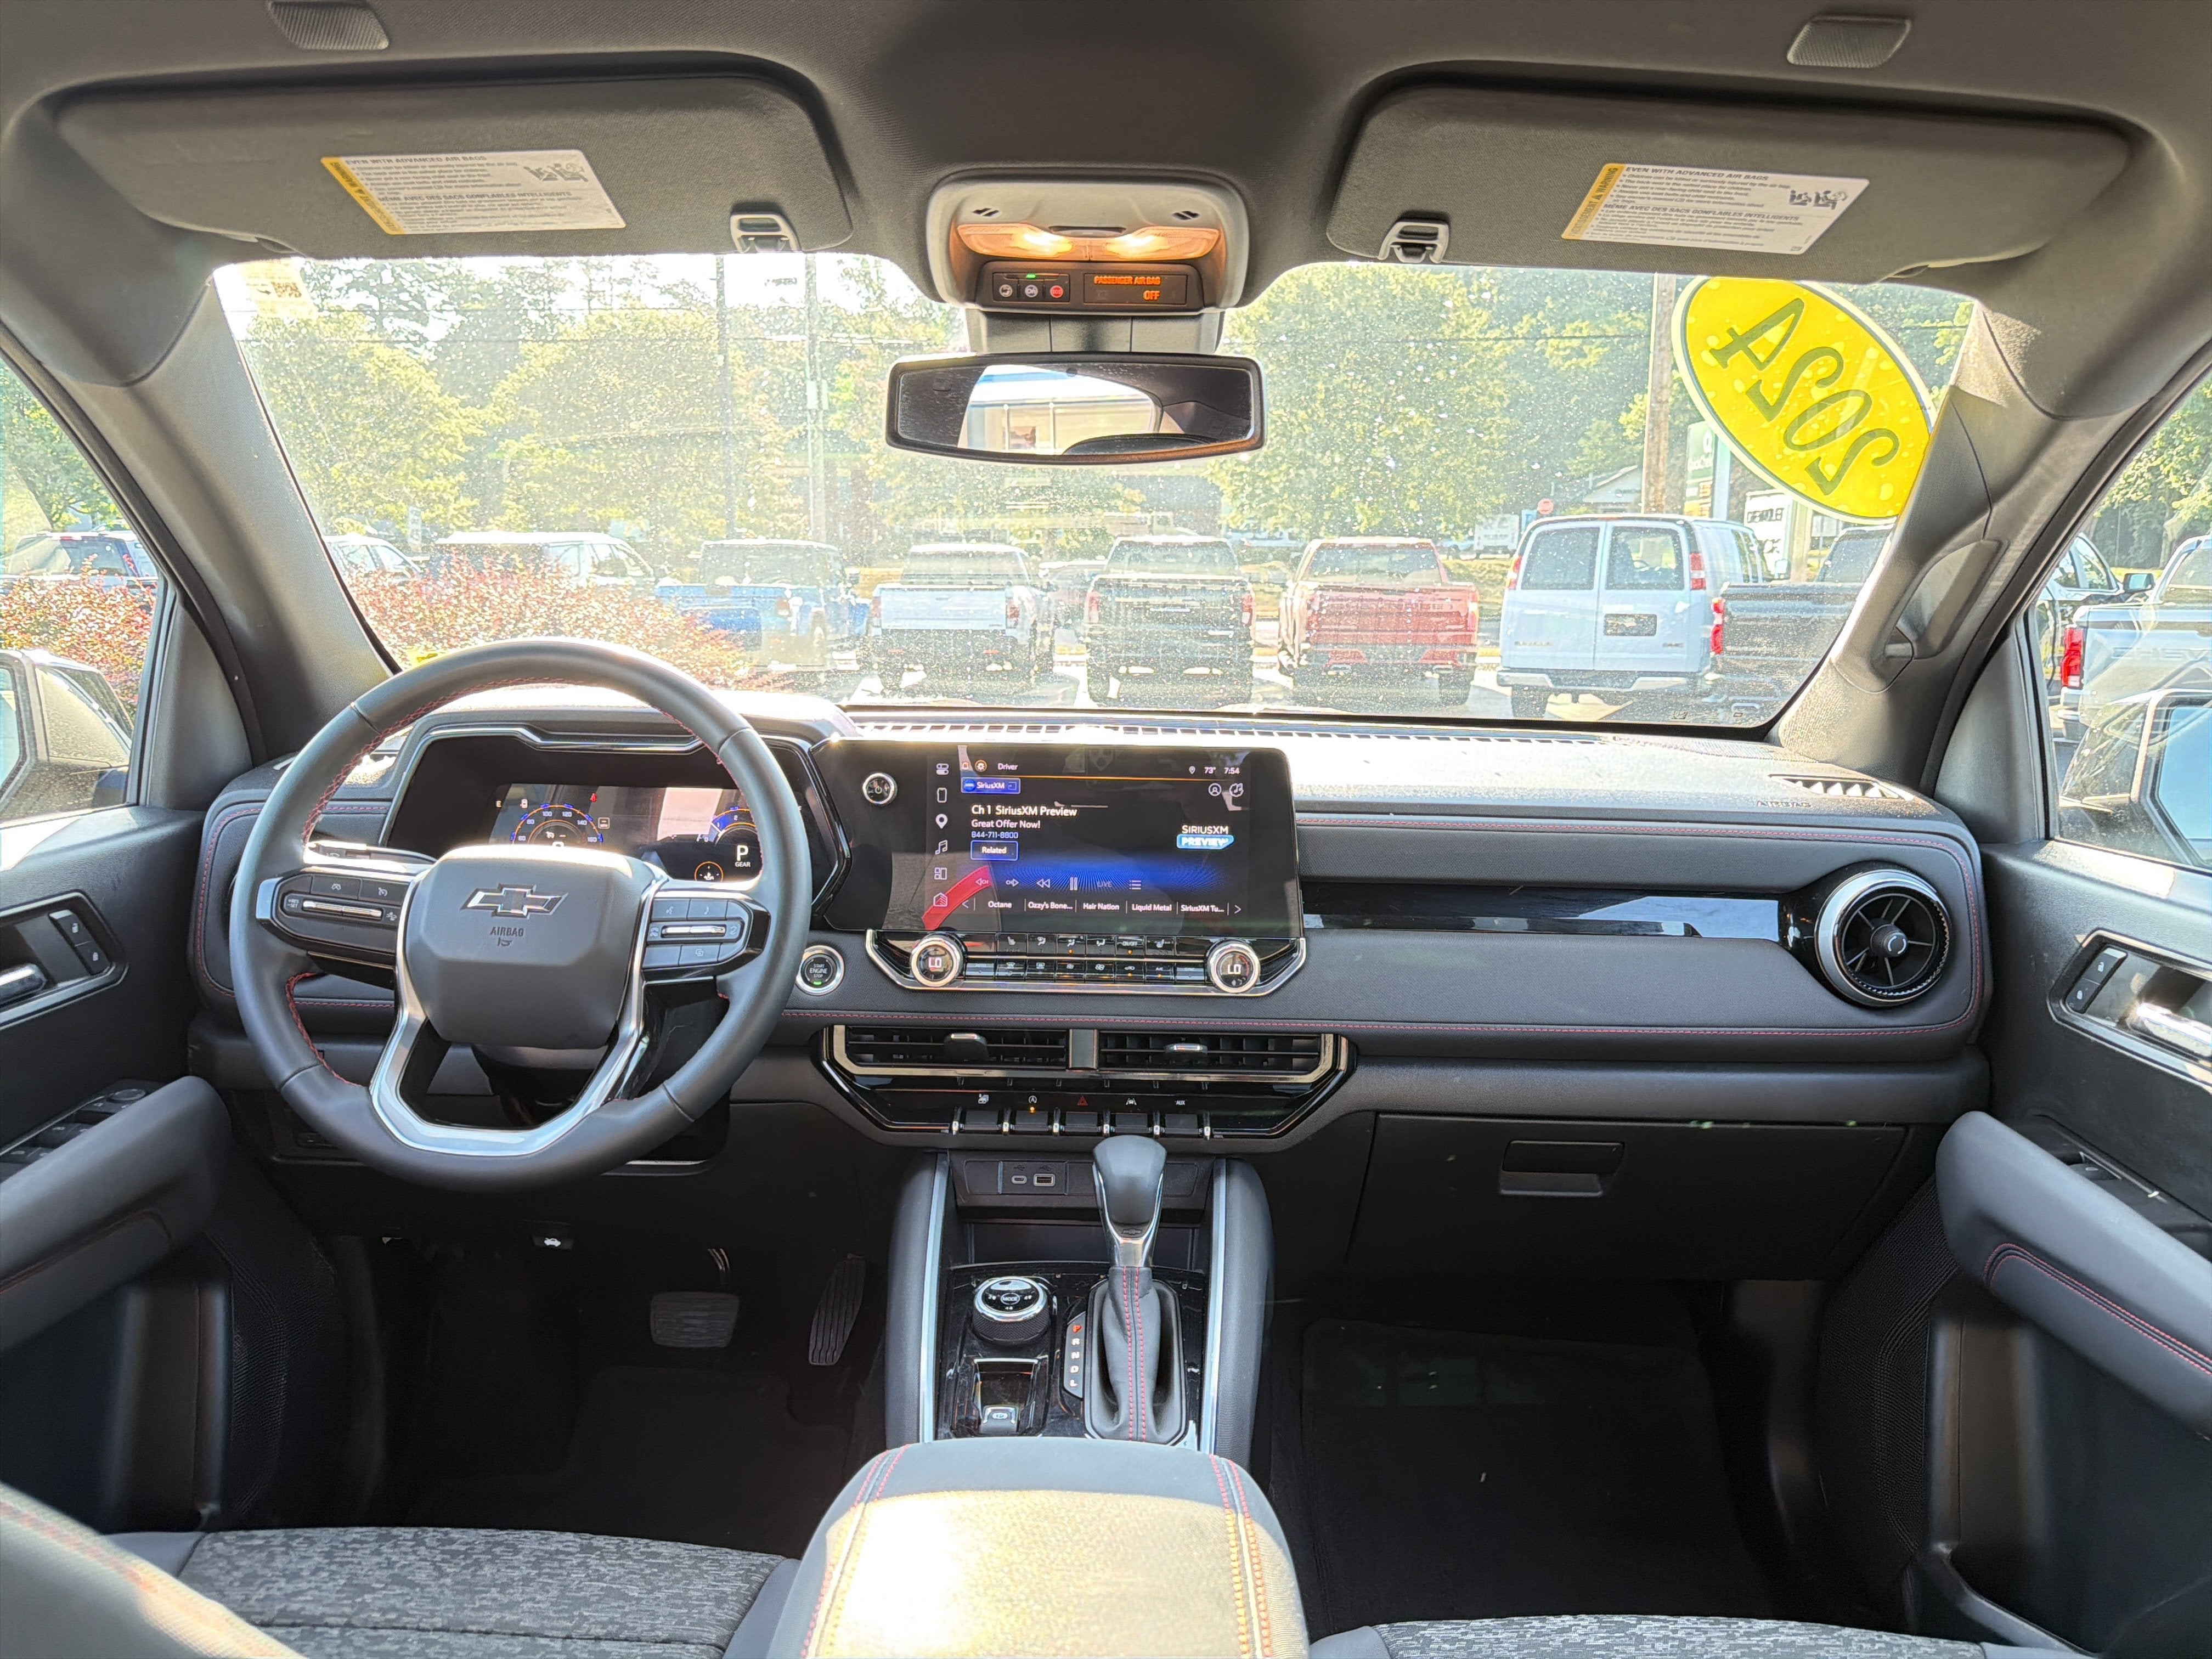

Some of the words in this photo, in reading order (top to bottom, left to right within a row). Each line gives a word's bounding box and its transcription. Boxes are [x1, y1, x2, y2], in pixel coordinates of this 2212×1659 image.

[1675, 170, 1724, 178] ADVANCED
[1692, 209, 1743, 217] GONFLABLES
[1744, 213, 1800, 221] INTELLIGENTS
[1094, 276, 1133, 285] PASSENGER
[1133, 276, 1146, 285] AIR
[1143, 290, 1160, 300] OFF
[971, 805, 985, 815] Ch
[987, 805, 992, 815] 1
[995, 805, 1038, 816] SiriusXM
[1040, 806, 1078, 816] Preview
[971, 819, 995, 828] Great
[995, 820, 1018, 828] Offer
[1019, 820, 1041, 828] Now!
[1182, 825, 1229, 834] SIRIUSXM
[1181, 837, 1229, 847] PREVIEW
[736, 845, 749, 861] P
[988, 900, 1012, 909] Octane
[1028, 901, 1049, 910] Ozzy's
[1132, 904, 1152, 912] Liquid
[1181, 904, 1210, 912] SiriusXM
[490, 927, 524, 937] AIRBAG
[1227, 964, 1241, 975] LO
[1073, 1325, 1082, 1333] P
